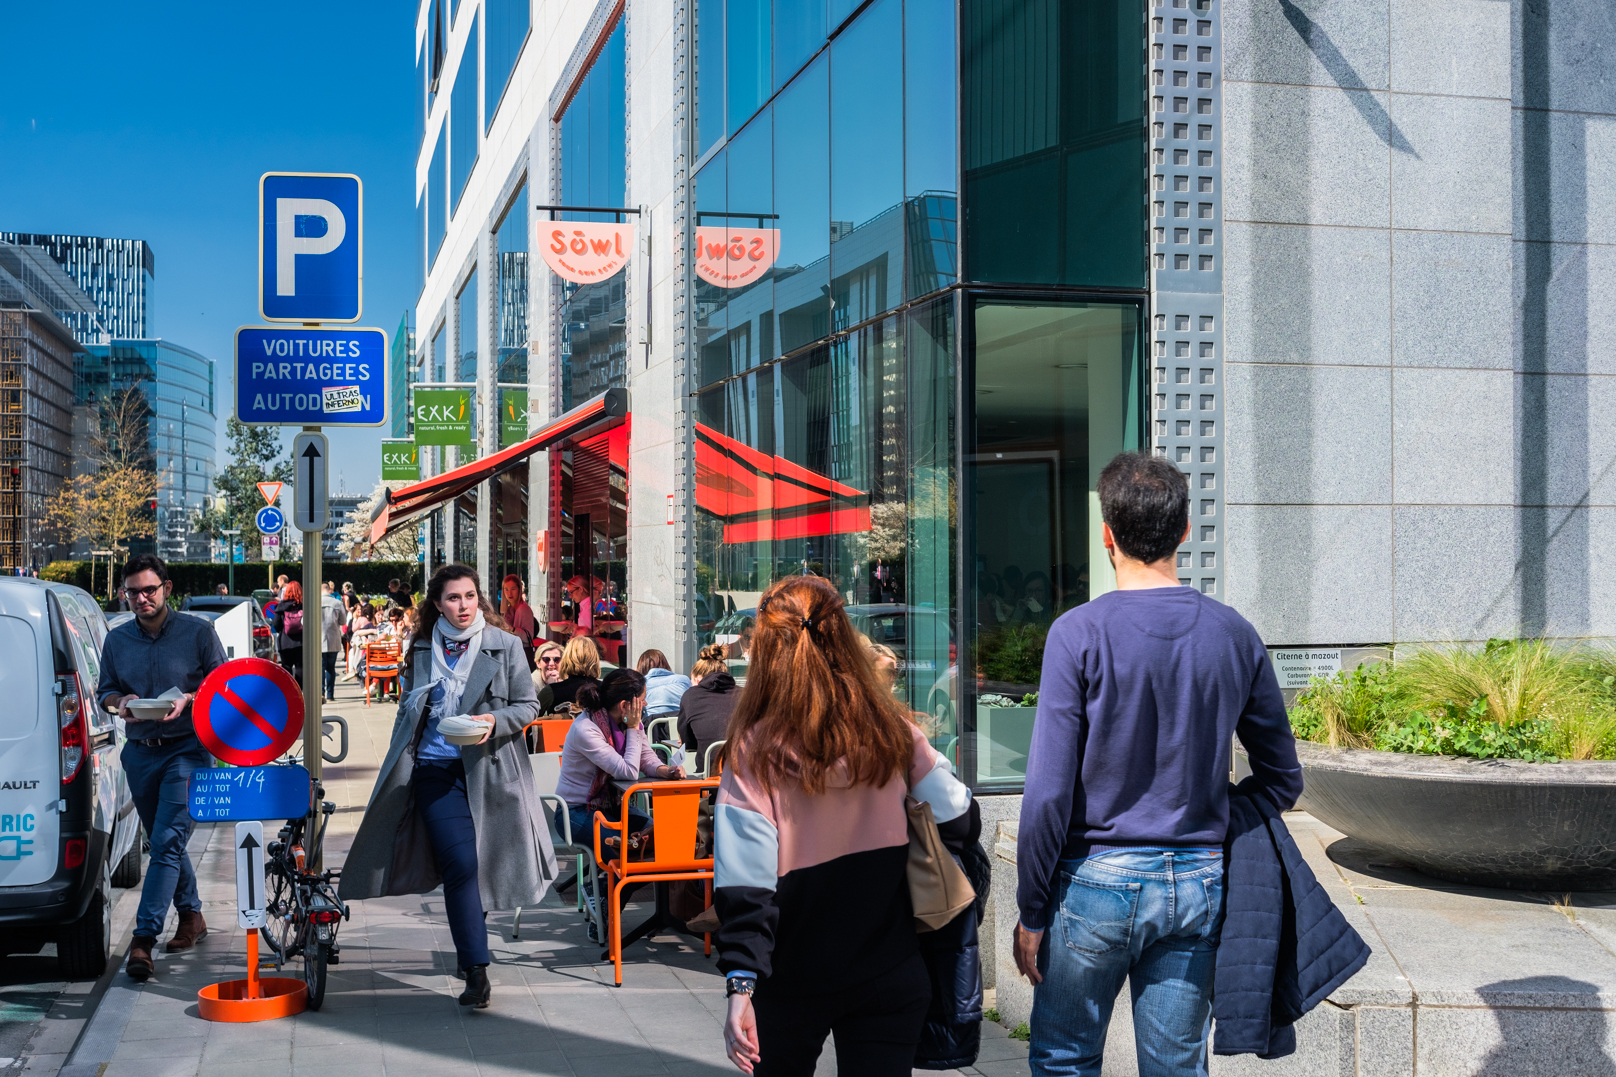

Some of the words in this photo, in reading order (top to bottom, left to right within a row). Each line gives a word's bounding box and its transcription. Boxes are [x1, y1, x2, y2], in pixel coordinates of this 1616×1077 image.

[276, 197, 347, 297] P
[597, 260, 618, 275] BOWL
[262, 338, 361, 358] VOITURES
[251, 362, 371, 381] PARTAGEES
[252, 393, 371, 411] AUTODN
[324, 389, 360, 402] ULTRAS
[325, 397, 360, 410] INFERNO
[1276, 652, 1303, 660] Citerne
[1304, 651, 1310, 660] à
[1311, 652, 1339, 660] mazout
[195, 772, 208, 780] DU
[214, 772, 232, 780] VAN
[234, 769, 265, 794] 1/4
[0, 780, 40, 790] AULT
[195, 785, 208, 793] AU
[214, 784, 231, 793] TOT
[195, 797, 206, 805] DE
[213, 796, 231, 804] VAN
[197, 809, 204, 817] A
[214, 808, 231, 816] TOT
[0, 813, 35, 833] RIC
